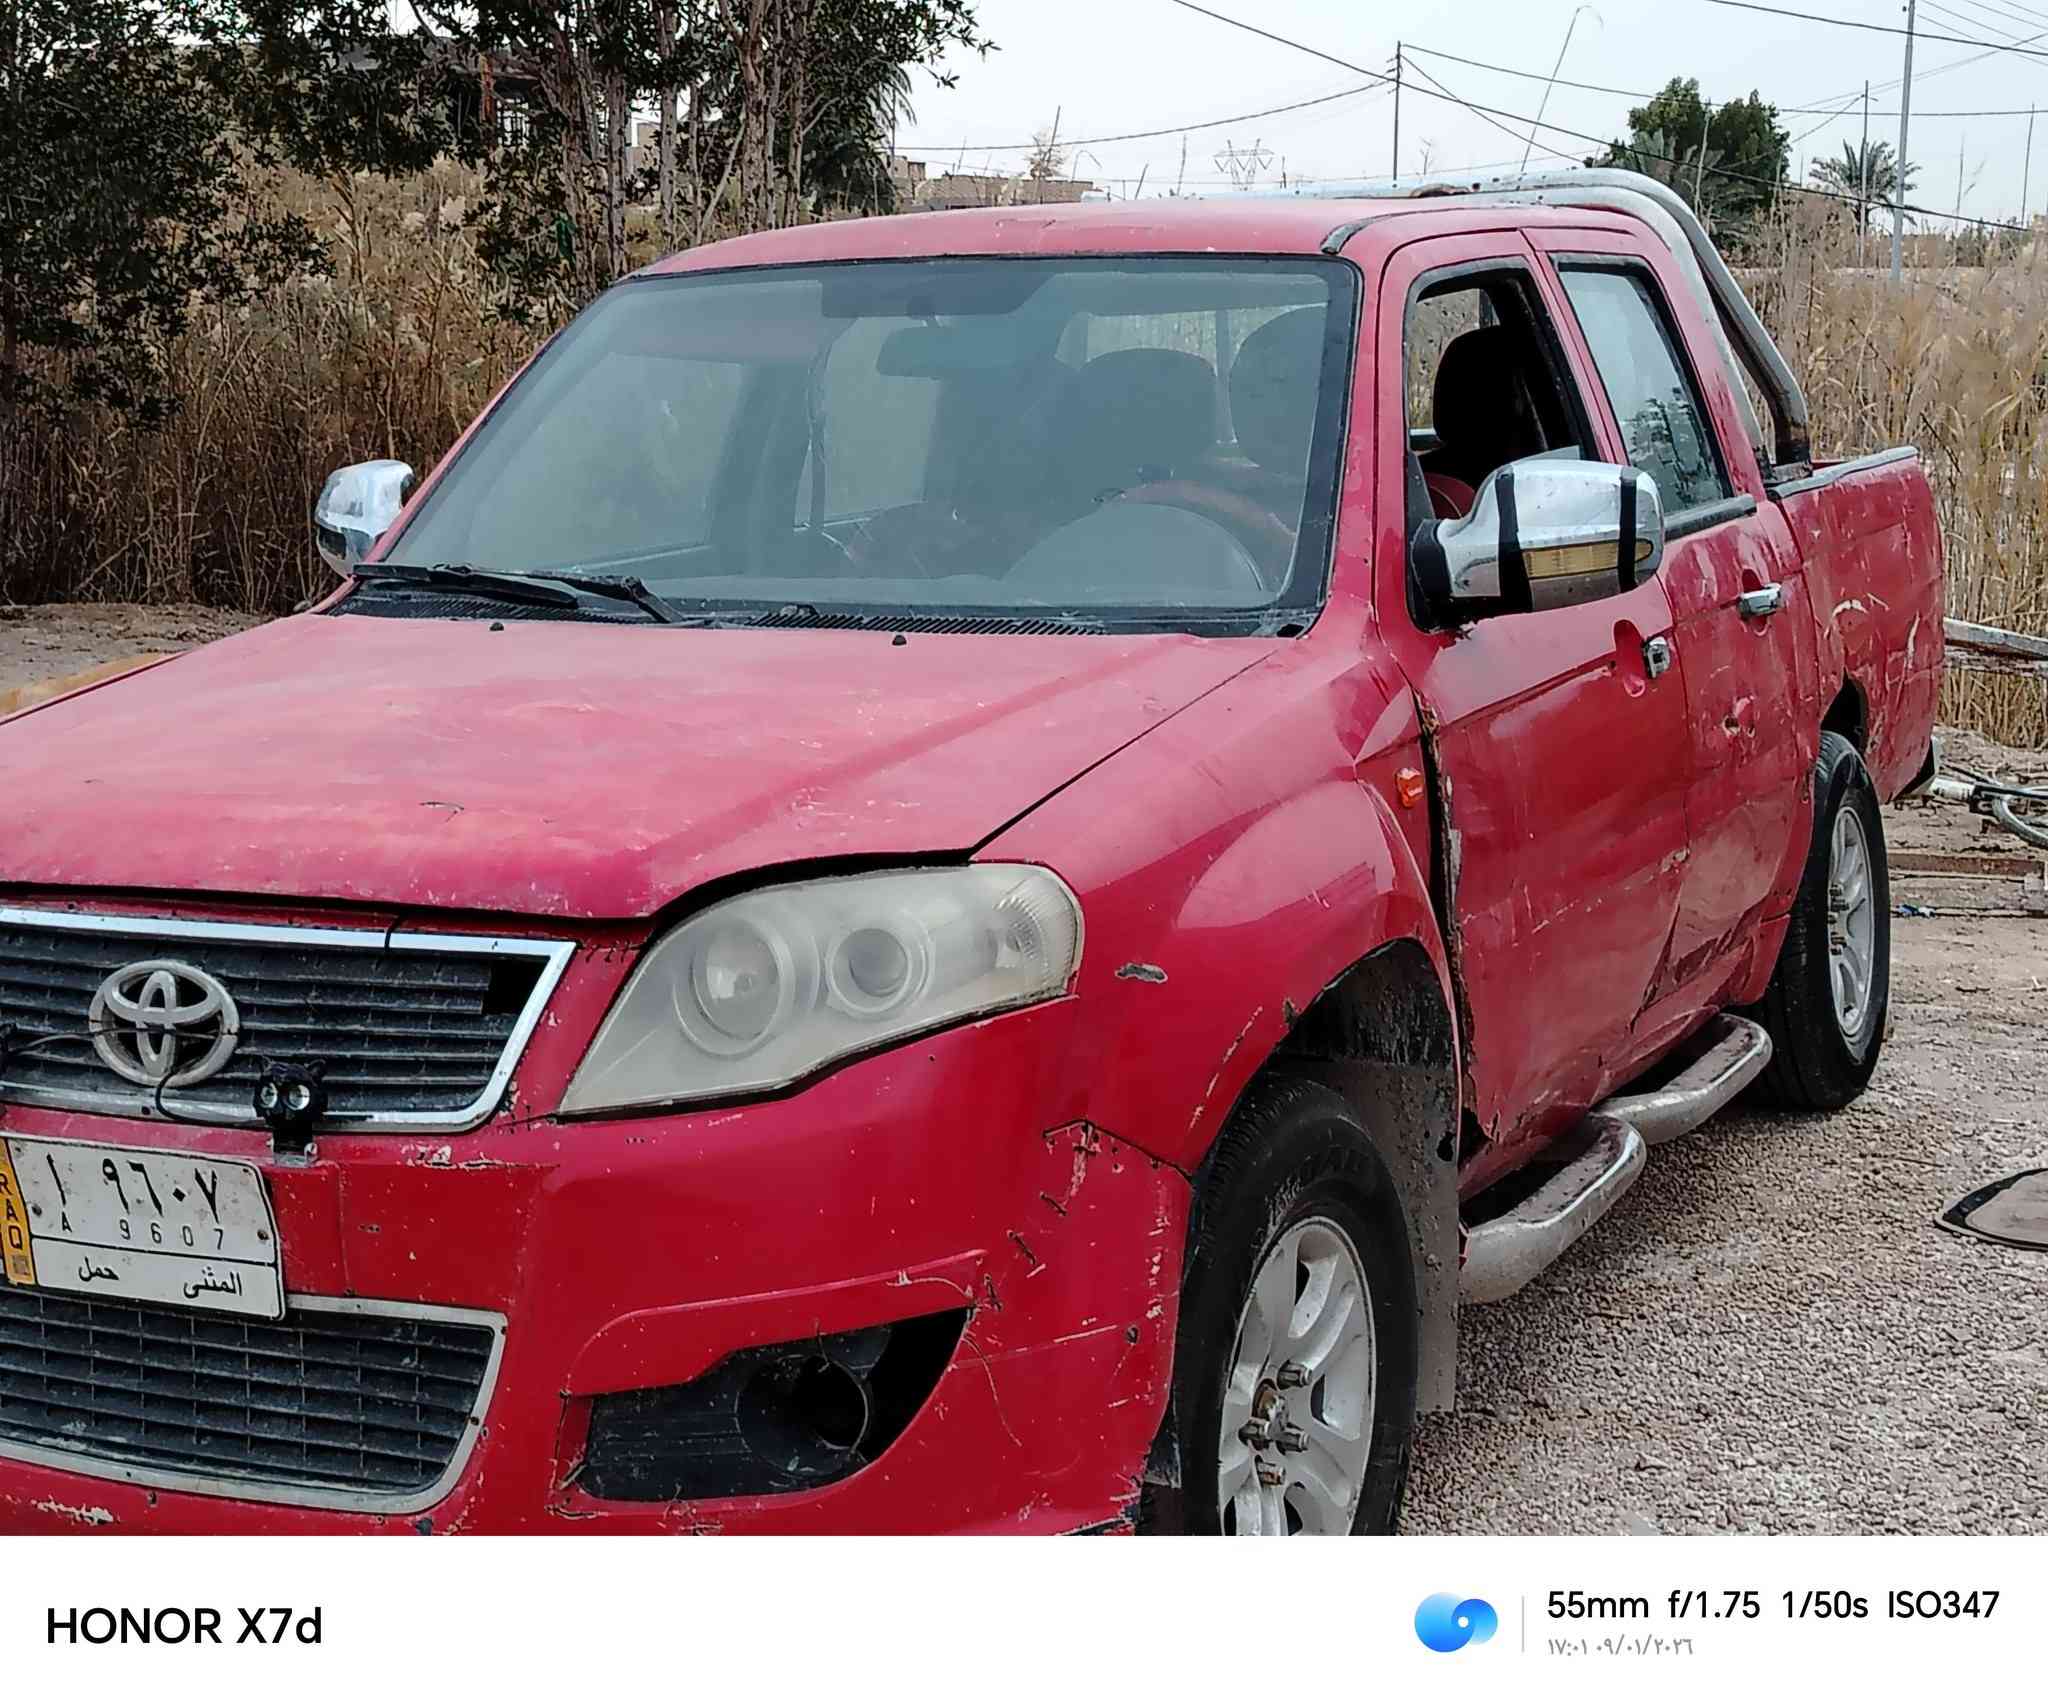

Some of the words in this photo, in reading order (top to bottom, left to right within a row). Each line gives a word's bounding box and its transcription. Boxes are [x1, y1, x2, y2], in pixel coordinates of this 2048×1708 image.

[102, 1158, 220, 1225] ٩٦٠٧
[61, 1211, 73, 1233] A
[119, 1218, 224, 1251] 9607
[78, 1256, 119, 1282] حمل
[183, 1266, 243, 1298] المثنى
